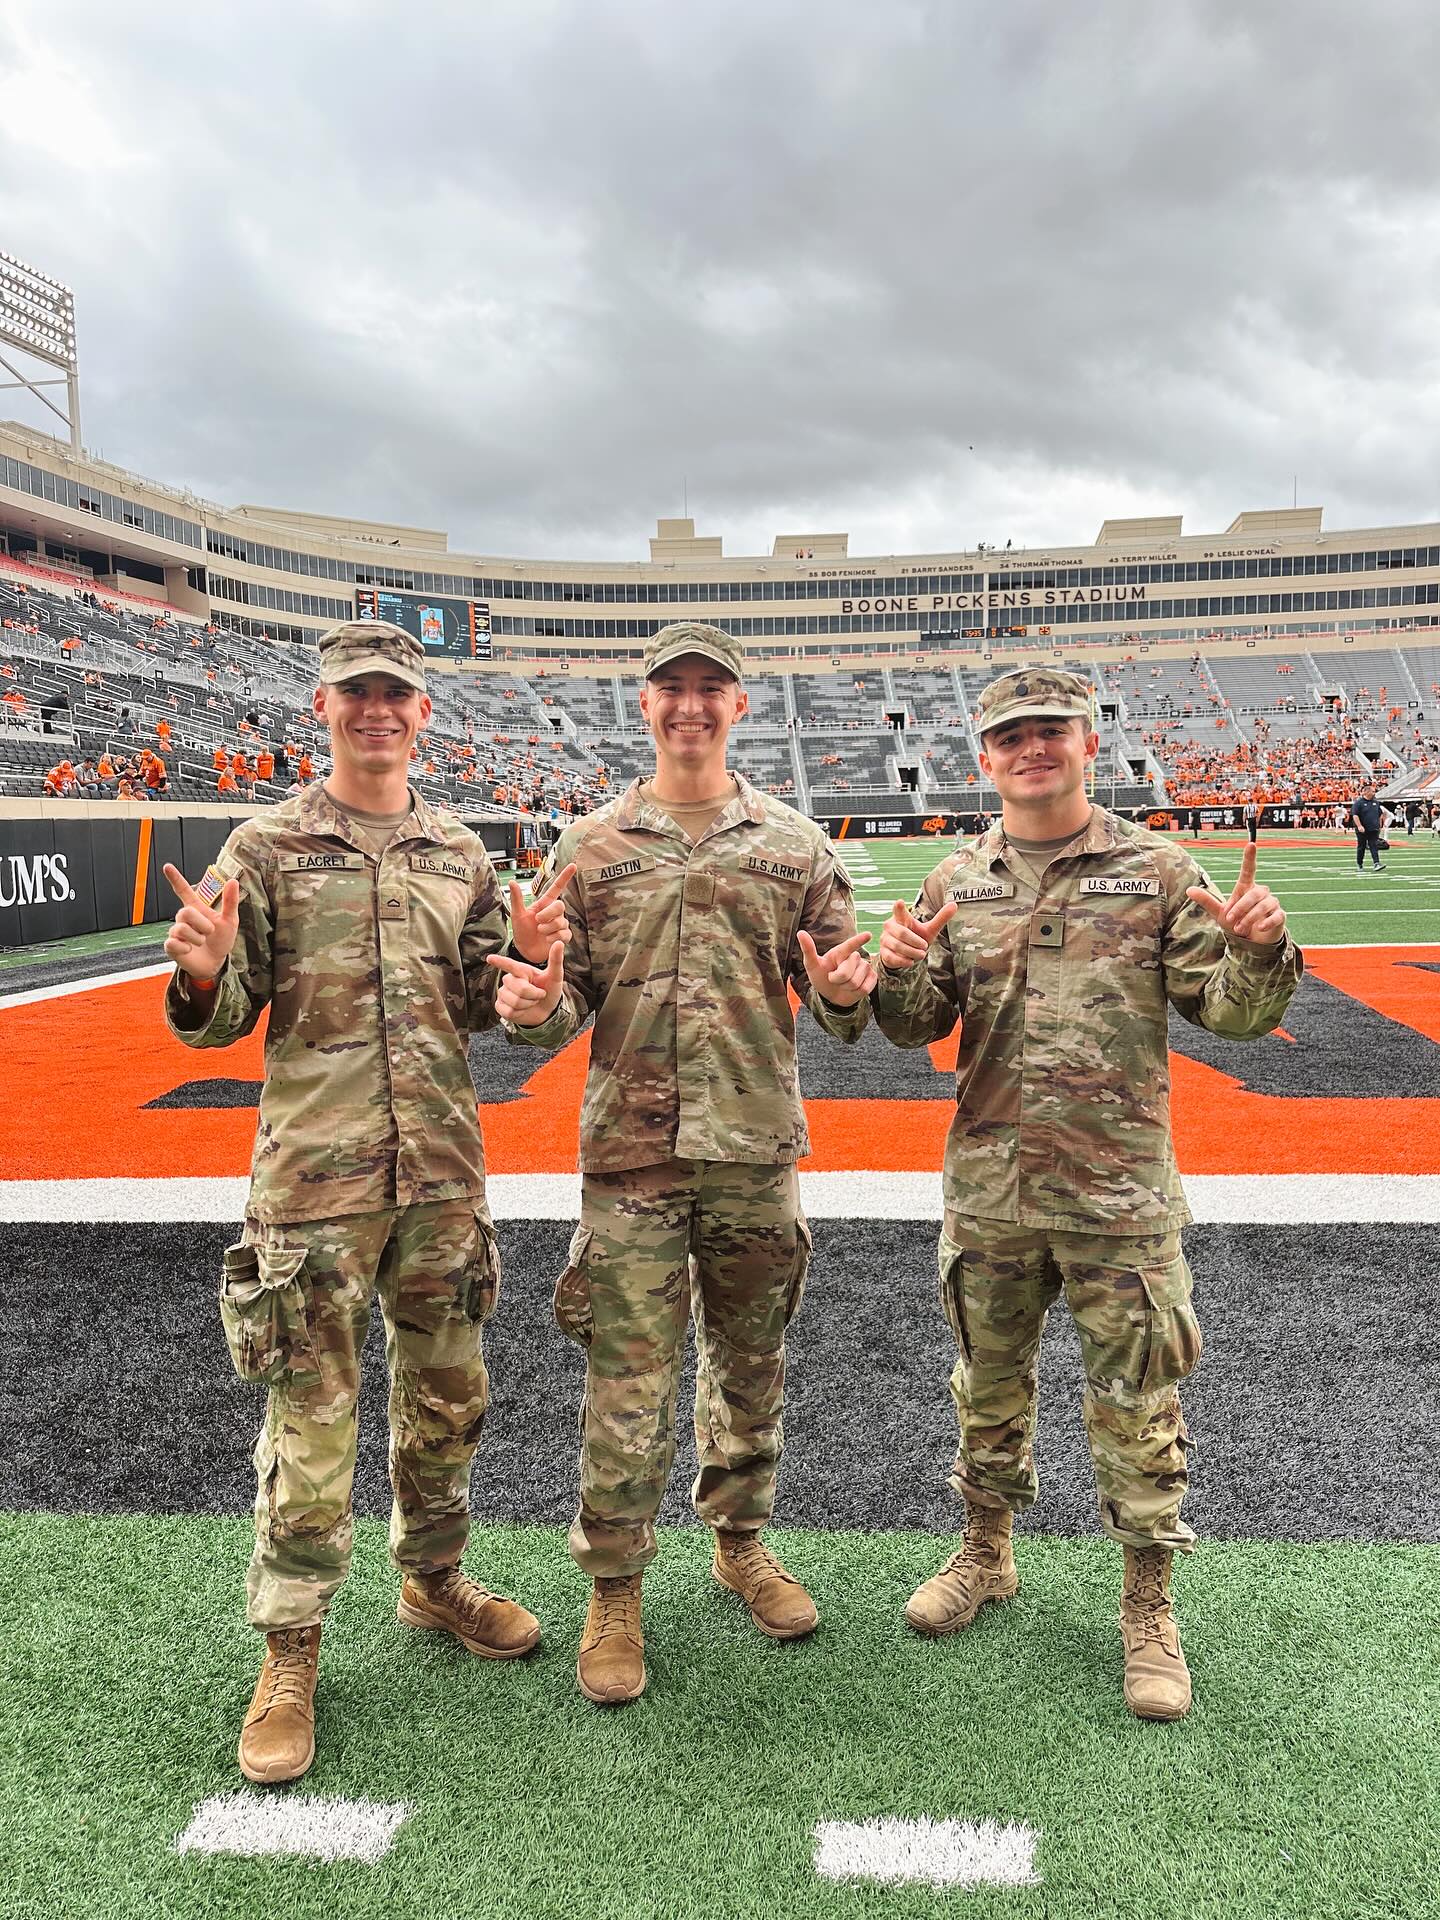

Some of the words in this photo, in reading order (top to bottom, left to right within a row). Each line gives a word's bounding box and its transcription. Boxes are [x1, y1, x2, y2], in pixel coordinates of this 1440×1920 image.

[1217, 550, 1244, 558] LESLIE
[938, 565, 974, 573] SANDERS
[1012, 561, 1049, 569] THURMAN
[1051, 559, 1083, 567] THOMAS
[838, 569, 877, 577] FENIMORE
[842, 598, 918, 613] BOONE
[933, 593, 1031, 609] PICKENS
[1045, 586, 1145, 604] STADIUM
[1272, 810, 1286, 822] 34
[865, 821, 876, 834] 98
[297, 855, 348, 868] EACRET
[419, 859, 439, 872] U.S.
[442, 861, 467, 877] ARMY
[600, 859, 641, 880] AUSTIN
[770, 863, 803, 881] ARMY
[1088, 880, 1110, 892] U.S.
[1114, 881, 1151, 892] ARMY
[953, 886, 1003, 901] WILLIAMS
